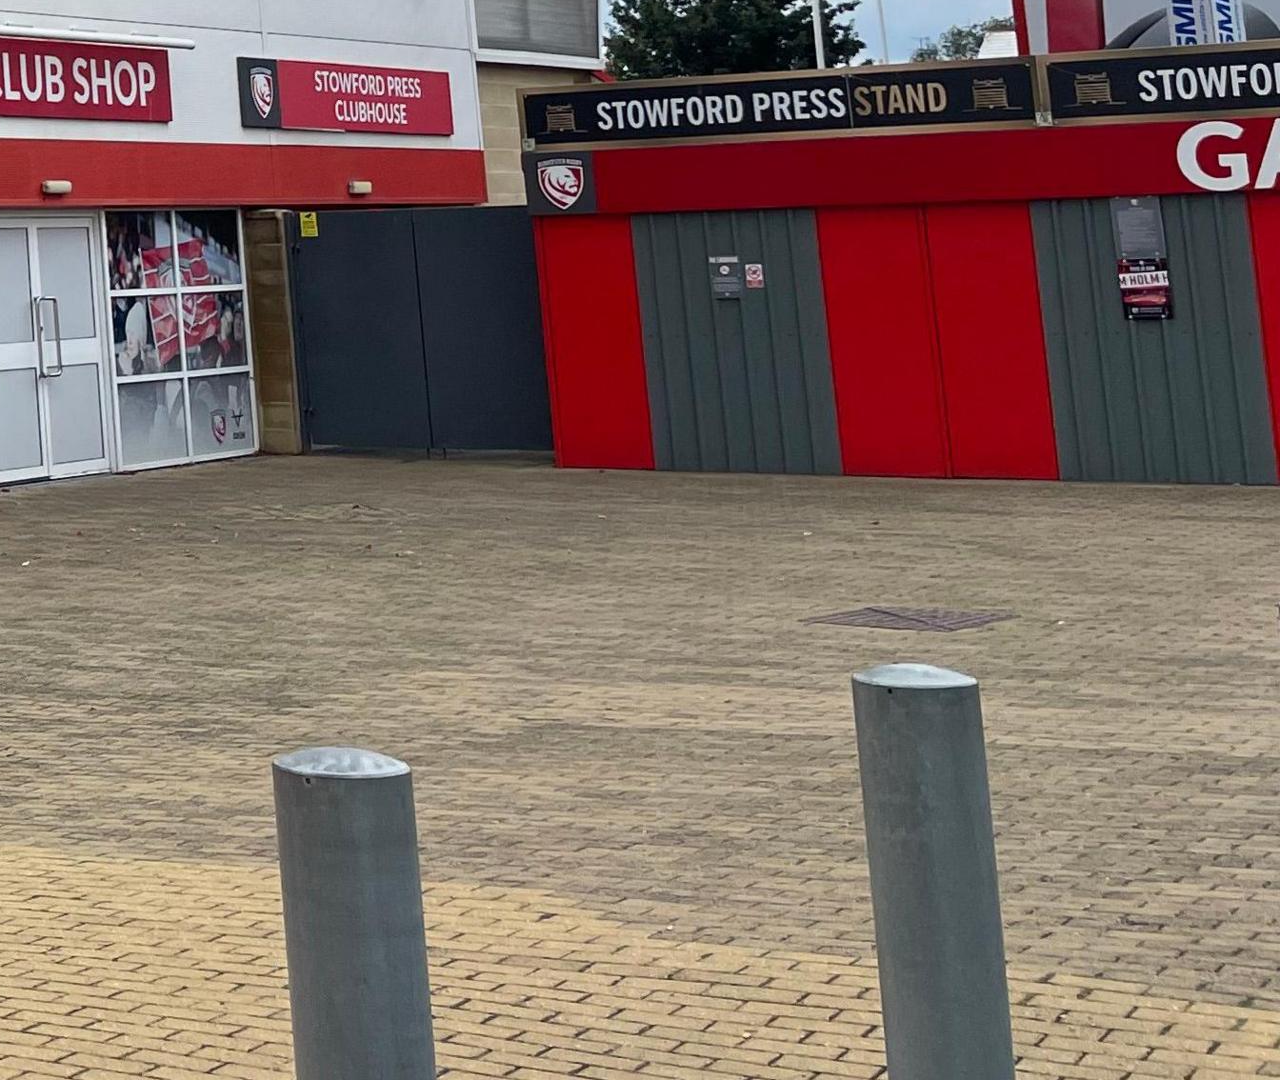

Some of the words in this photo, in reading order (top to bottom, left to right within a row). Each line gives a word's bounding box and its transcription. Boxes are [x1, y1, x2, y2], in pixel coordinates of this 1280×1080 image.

[72, 56, 156, 108] SHOP
[313, 70, 385, 96] STOWFORD
[386, 75, 422, 99] PRESS
[334, 100, 408, 126] CLUBHOUSE
[596, 93, 744, 130] STOWFORD
[752, 87, 847, 123] PRESS
[853, 82, 948, 116] STAND
